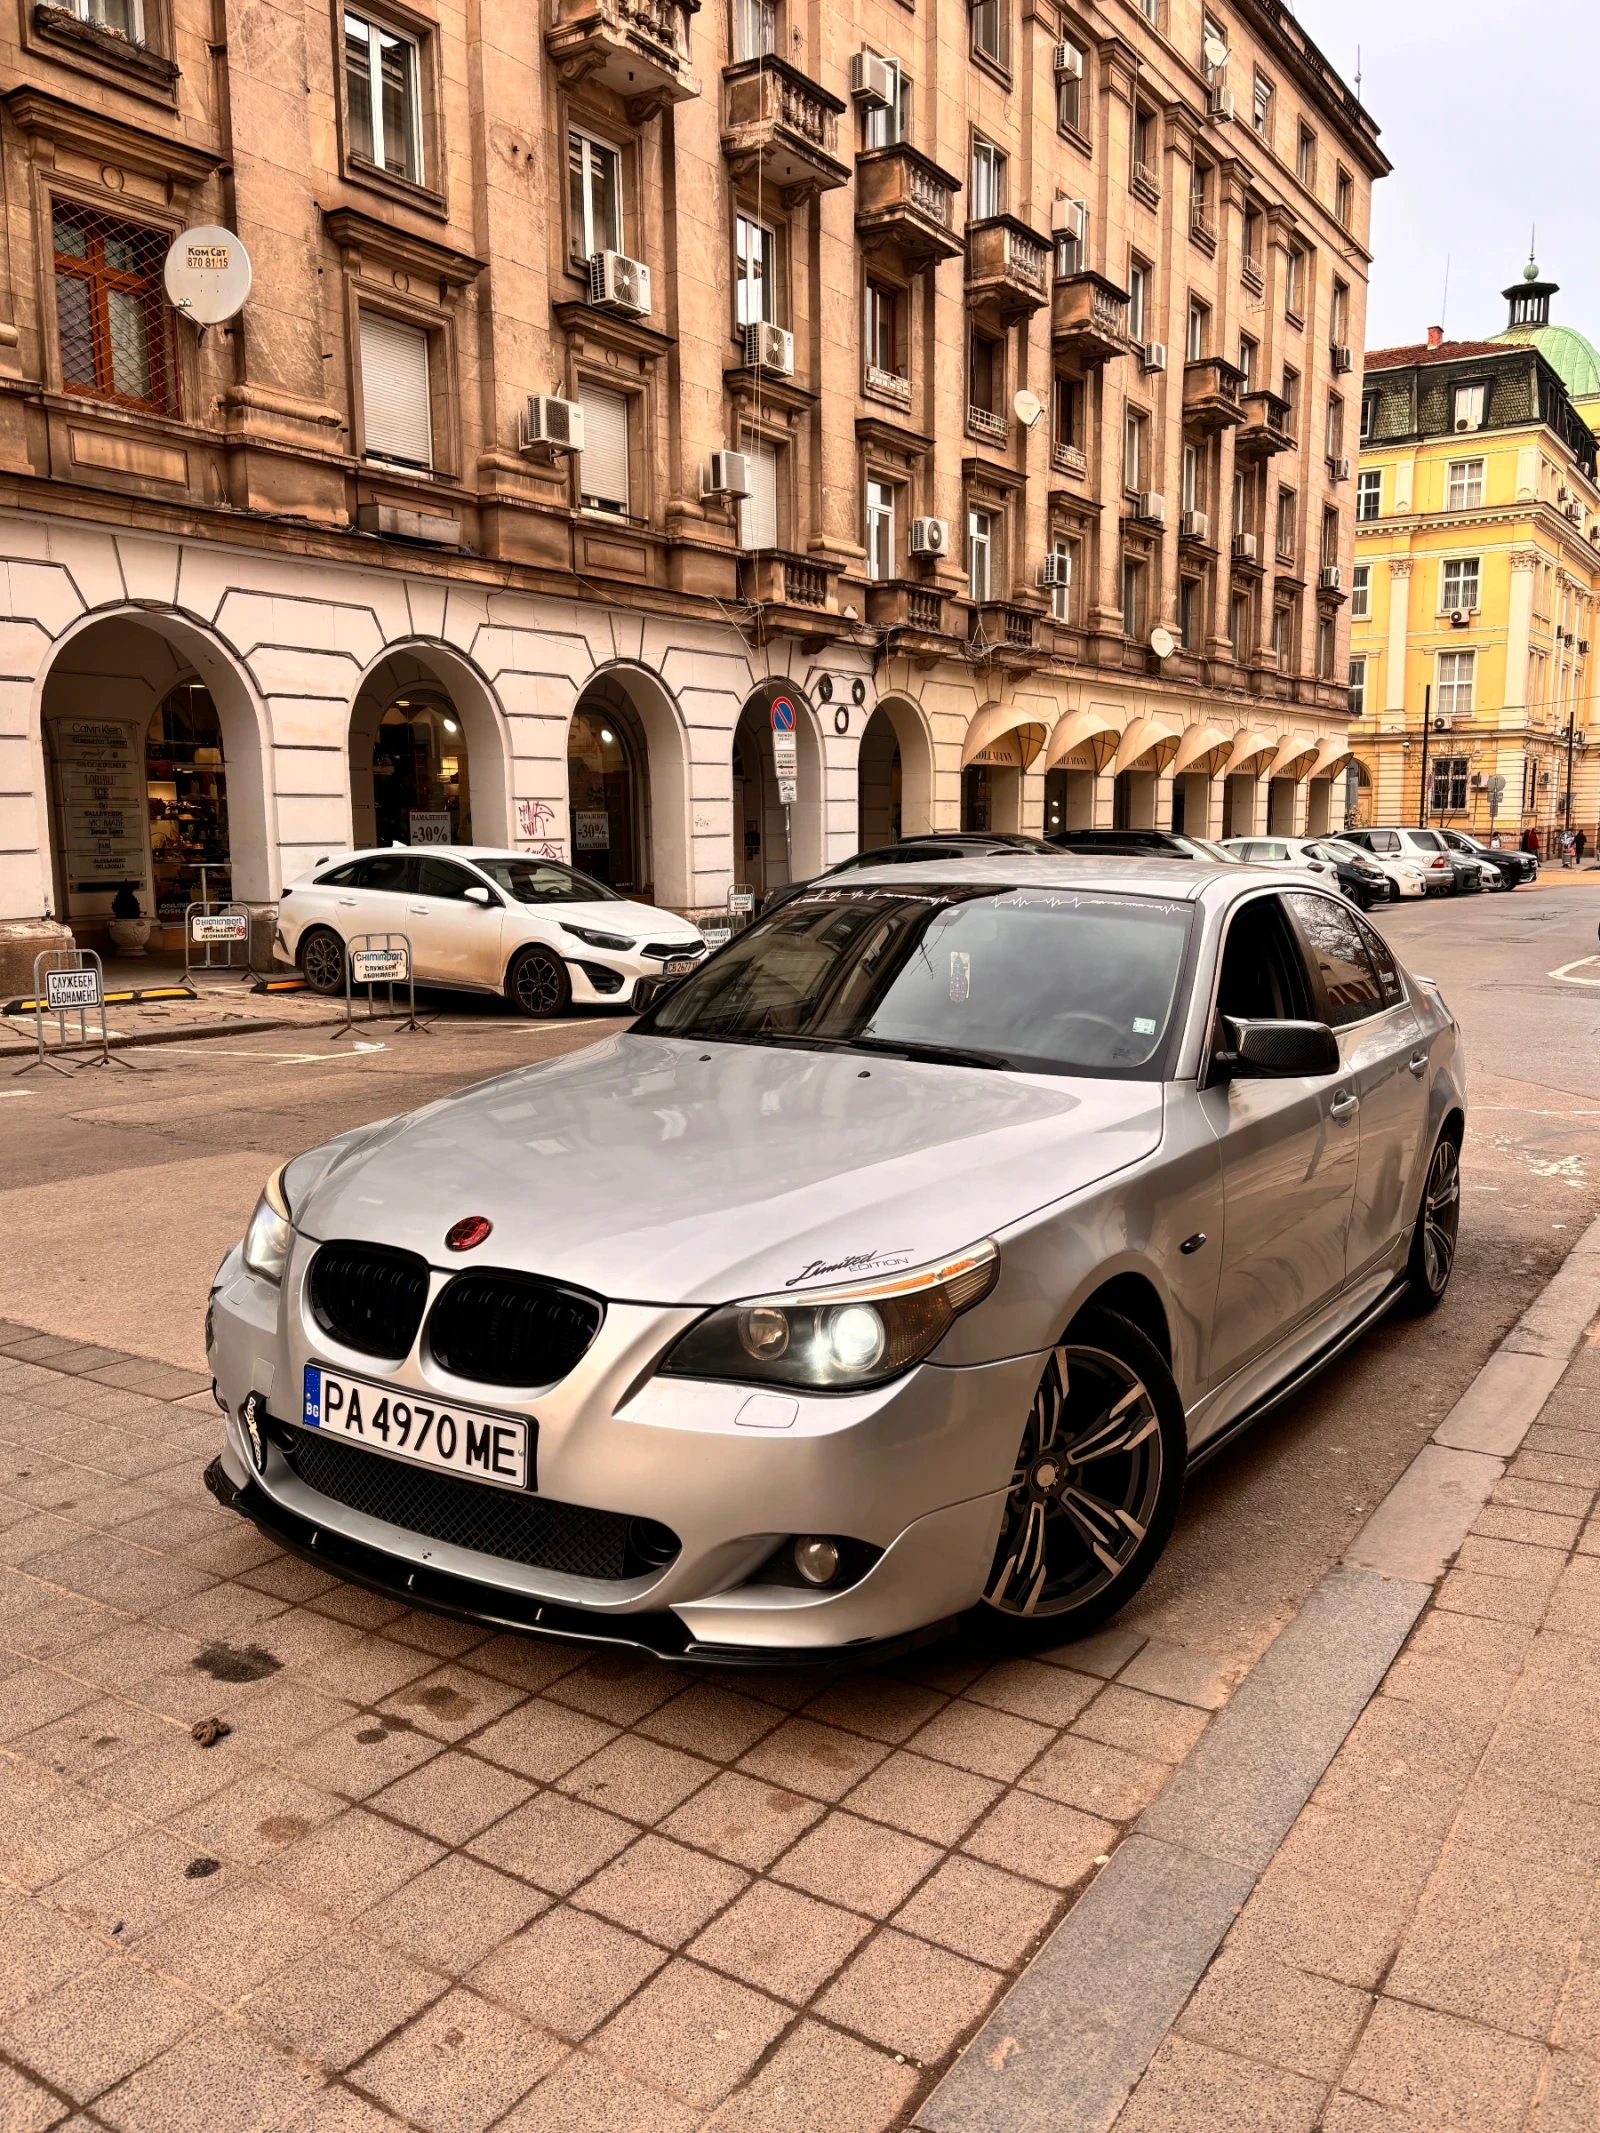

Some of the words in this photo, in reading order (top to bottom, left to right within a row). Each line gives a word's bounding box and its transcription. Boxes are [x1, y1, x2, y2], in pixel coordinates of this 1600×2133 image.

[187, 247, 209, 256] Ком
[210, 248, 227, 256] Сат
[187, 257, 203, 267] 870
[72, 723, 100, 734] Calvin
[101, 724, 123, 735] Klein
[52, 975, 93, 989] СЛУЖЕБЕН
[51, 989, 96, 1004] АБОНАМЕНТ
[785, 1250, 880, 1286] Limited
[848, 1257, 909, 1273] EDITION
[306, 1402, 319, 1418] BG
[324, 1379, 364, 1434] PA
[372, 1397, 457, 1460] 4970
[466, 1419, 517, 1477] ME
